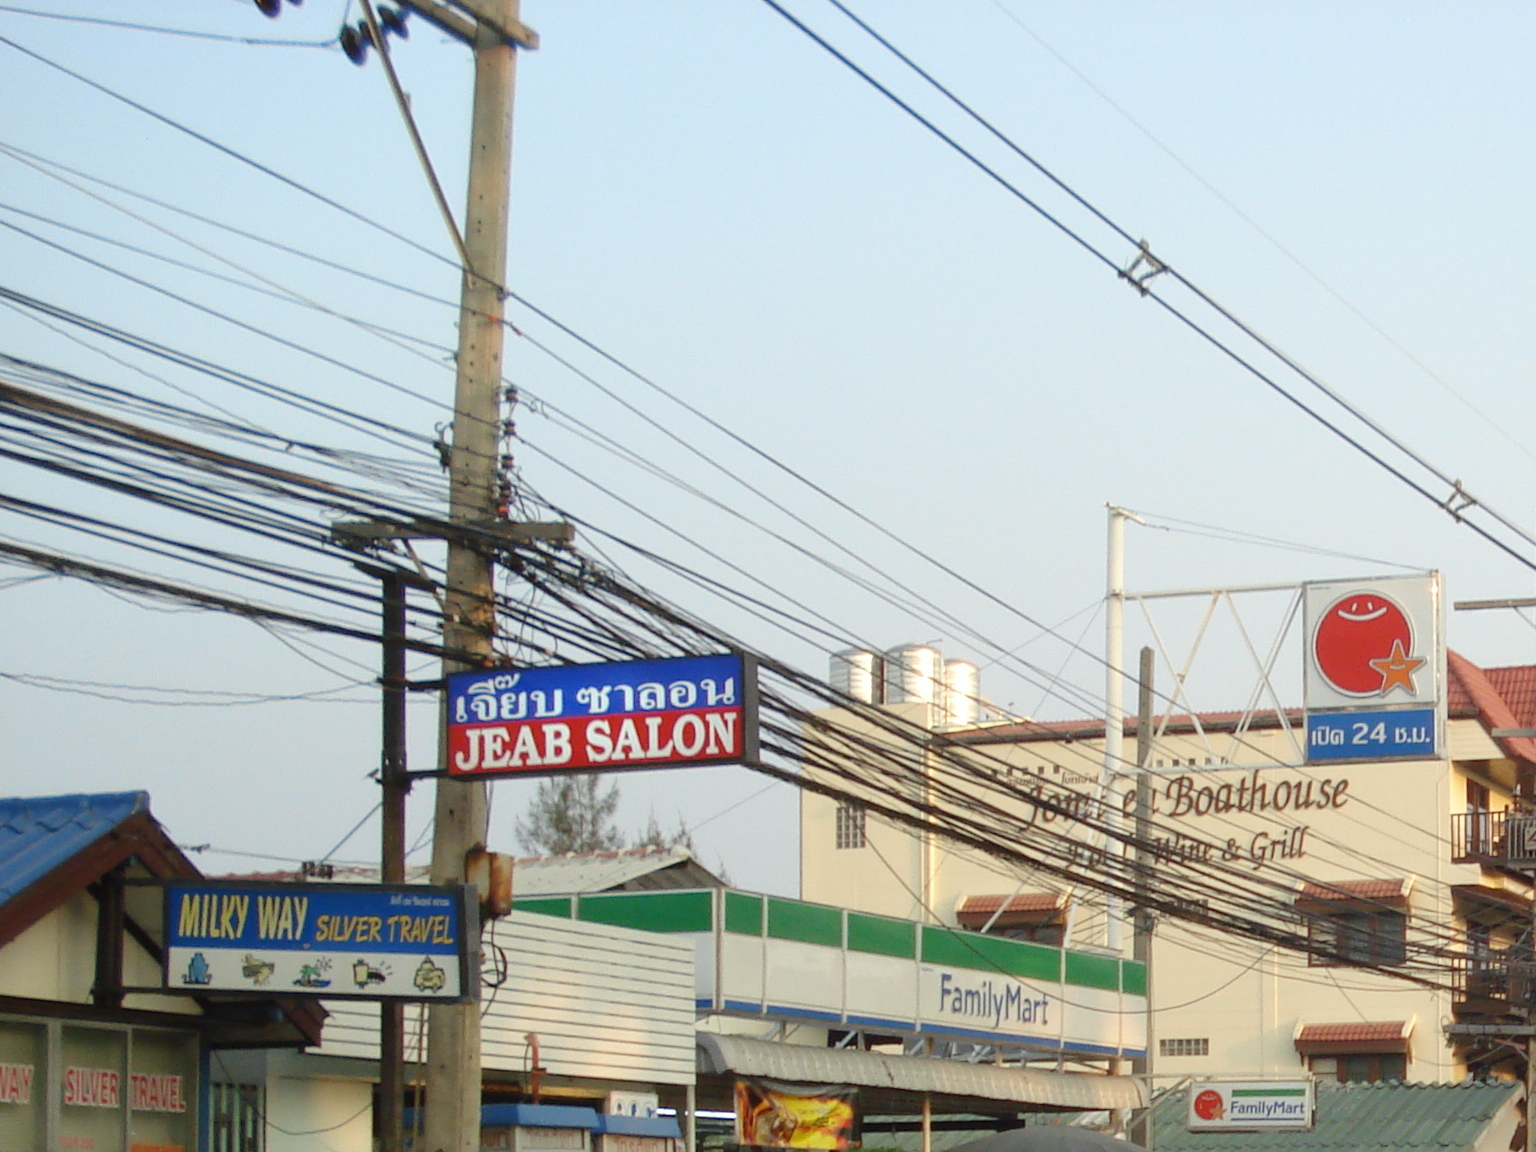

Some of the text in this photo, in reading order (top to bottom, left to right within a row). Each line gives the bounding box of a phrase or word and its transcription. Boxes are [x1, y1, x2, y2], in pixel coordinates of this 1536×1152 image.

[455, 672, 736, 723] เจี๊ยบ ซาลอน
[455, 712, 738, 771] JEAB SALON
[1311, 722, 1431, 746] เปิด 24 ช.ม.
[1166, 769, 1350, 817] Boathouse
[1221, 837, 1241, 862] &
[1251, 826, 1310, 870] Grill
[178, 894, 455, 945] MILKY WAY SILVER TRAVEL
[940, 973, 1049, 1029] FamilyMart
[65, 1066, 120, 1109] SILVER
[131, 1073, 187, 1112] TRAVEL
[1230, 1101, 1305, 1117] FamilyMart
